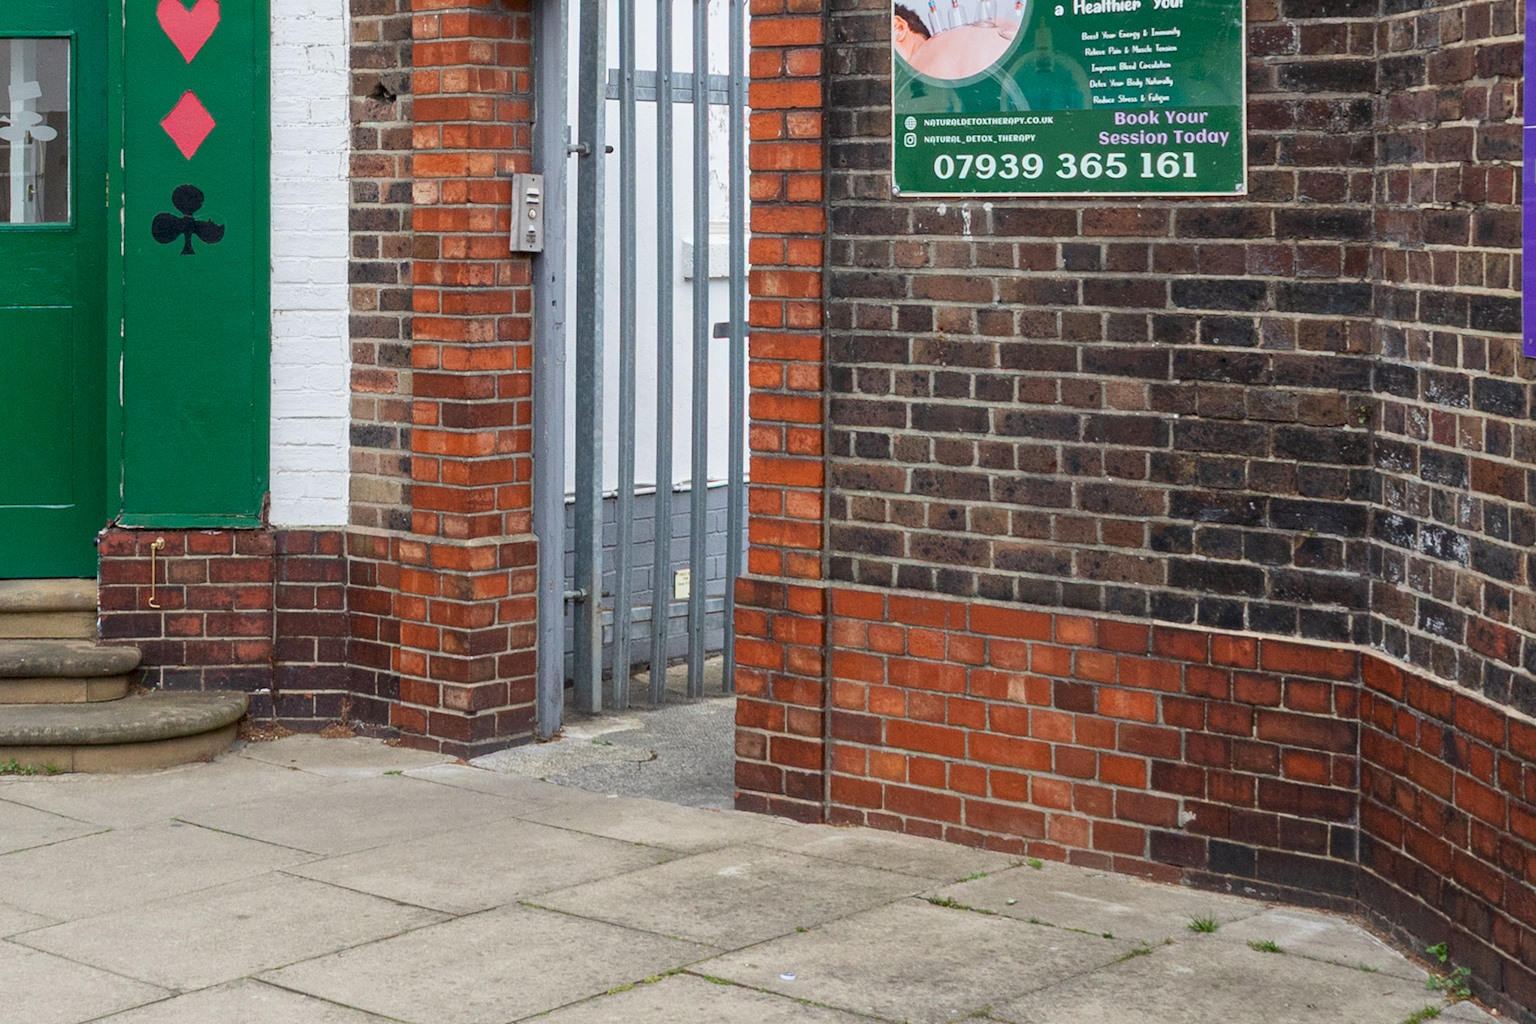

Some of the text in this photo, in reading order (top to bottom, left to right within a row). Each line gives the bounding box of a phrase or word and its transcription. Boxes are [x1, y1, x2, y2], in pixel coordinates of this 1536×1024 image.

[1054, 4, 1064, 17] a
[1081, 26, 1181, 41] Boost Your Energy & Immunity
[1085, 43, 1177, 56] Relieve Pain & Muscle Tension
[1091, 60, 1171, 73] Improve Blood Circulation
[1089, 76, 1173, 88] Detox Your Body Naturally
[1093, 93, 1170, 104] Reduce Stress & Fatigue
[924, 116, 1054, 127] NATURALDETOXTHERAPY.CO.UK
[1114, 110, 1209, 126] Book Your
[1099, 129, 1230, 146] Session Today
[933, 151, 1197, 180] 07939 365 161
